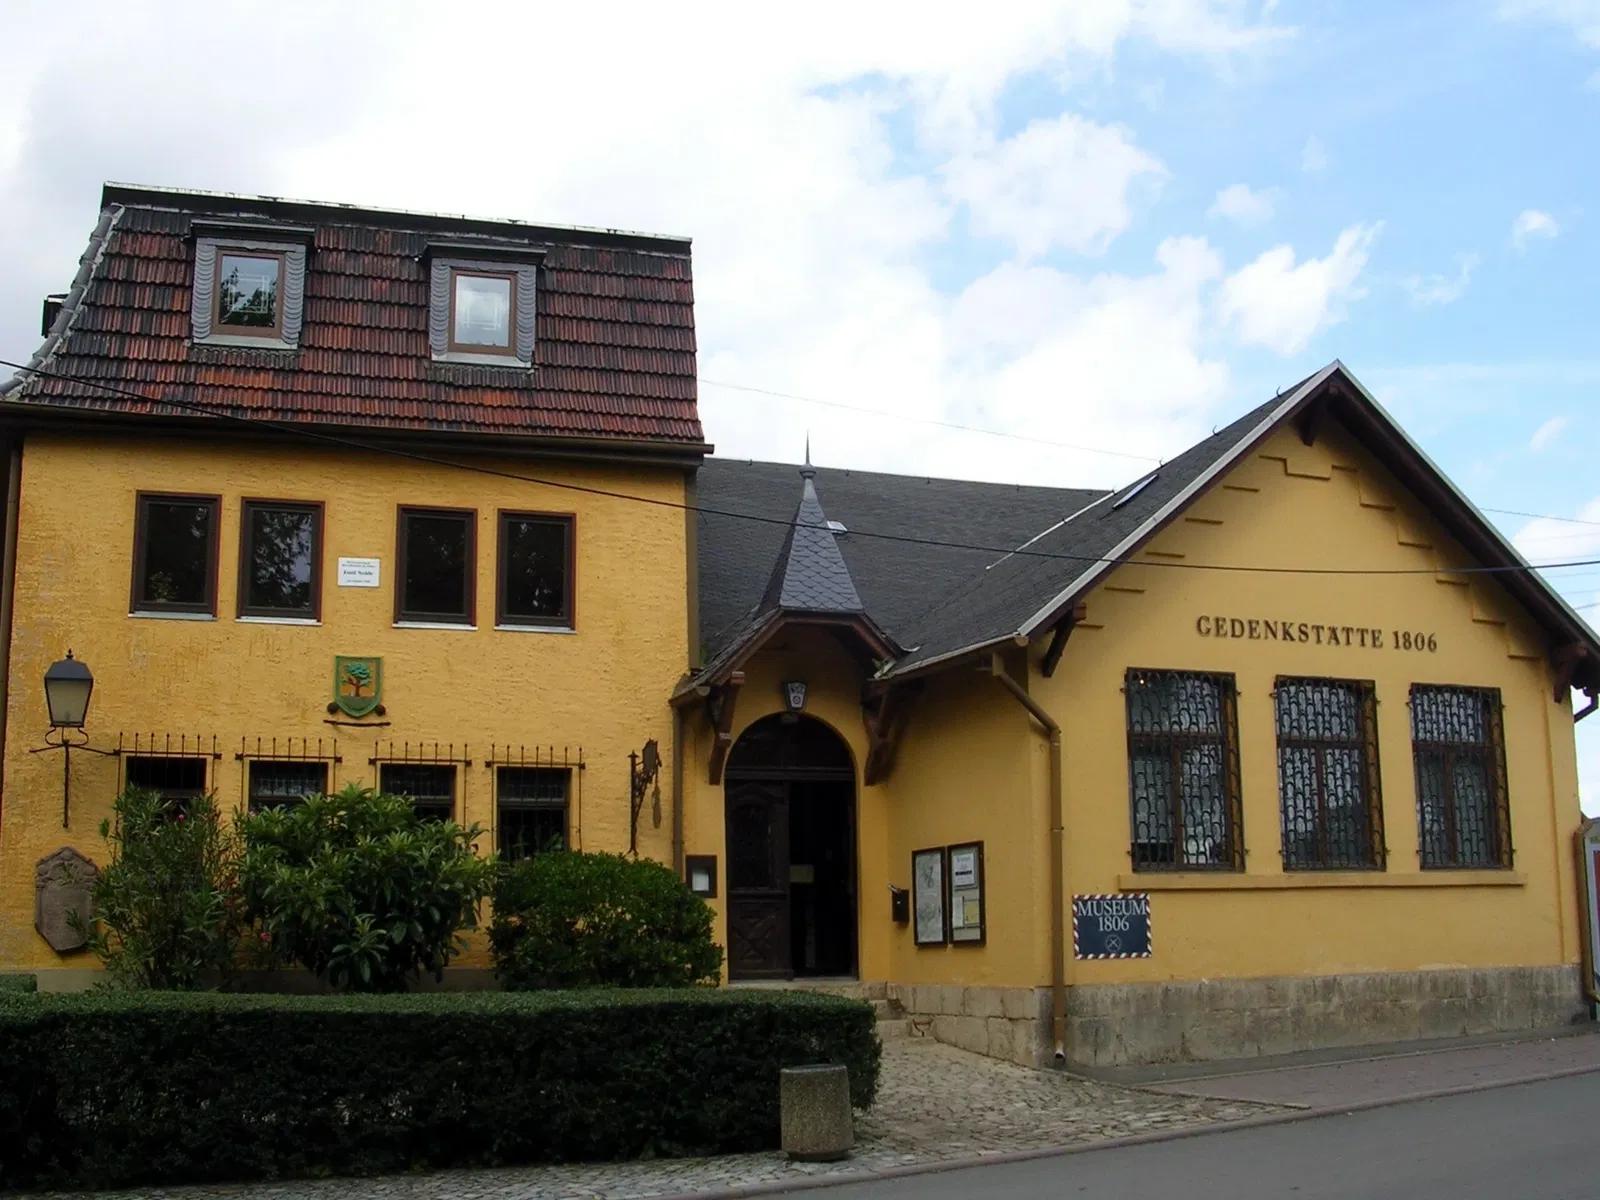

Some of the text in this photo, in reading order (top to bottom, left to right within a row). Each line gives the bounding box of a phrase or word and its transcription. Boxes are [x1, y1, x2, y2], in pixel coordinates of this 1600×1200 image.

[1196, 615, 1438, 653] GEDENKSTÄTTE 1806
[1077, 900, 1147, 916] MUSEUM
[1098, 915, 1130, 932] 1806
